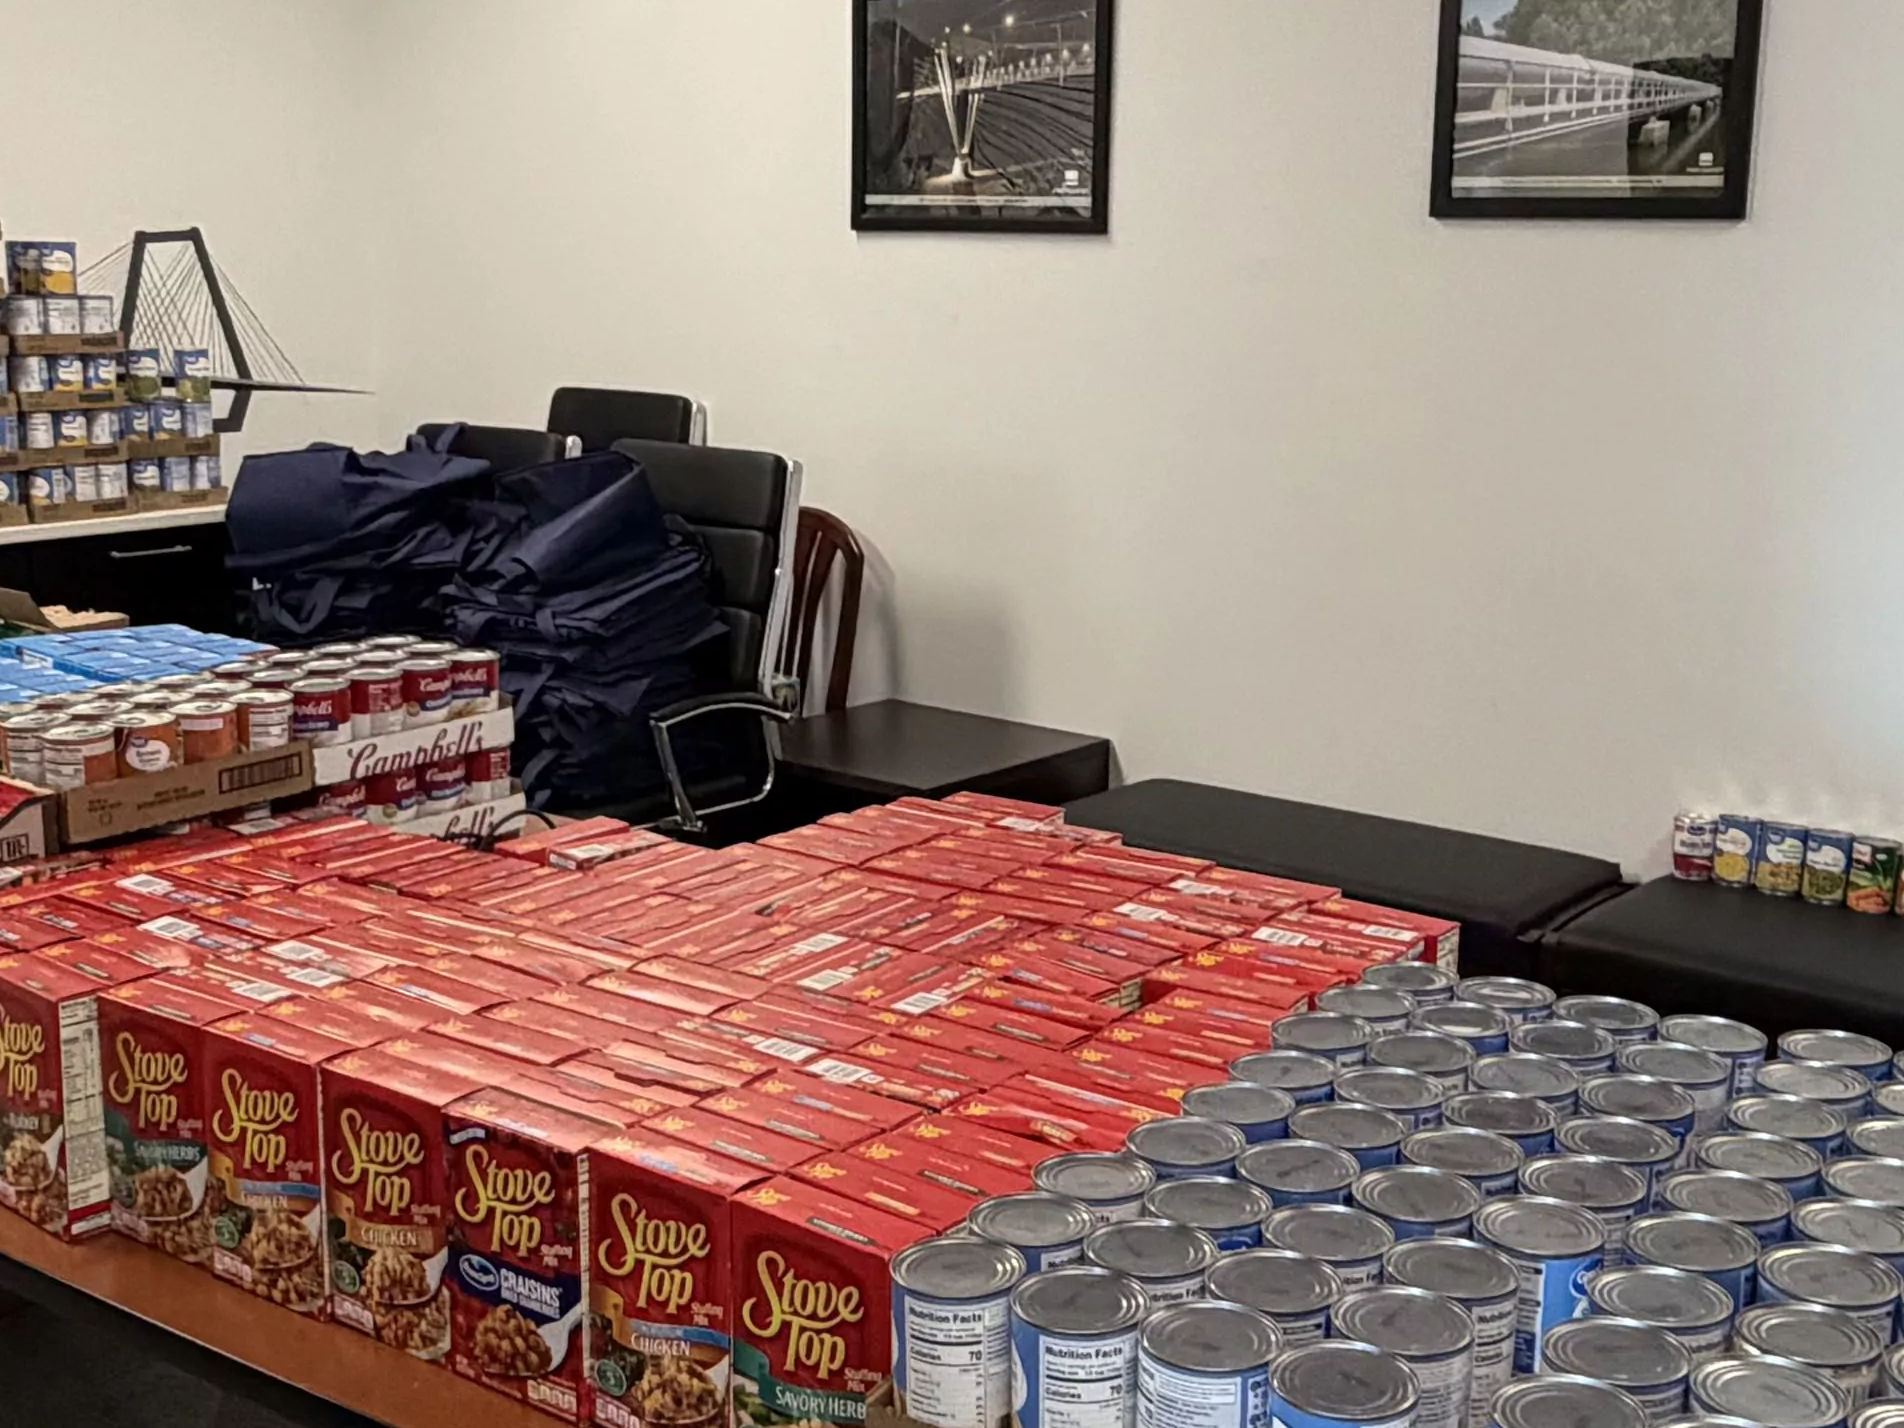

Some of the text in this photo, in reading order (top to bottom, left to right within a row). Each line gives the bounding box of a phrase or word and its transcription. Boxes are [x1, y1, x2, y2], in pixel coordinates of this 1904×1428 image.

[348, 721, 483, 780] Campbell's
[3, 1053, 38, 1101] Top
[109, 1032, 188, 1103] Stove
[130, 1083, 178, 1131] Top
[212, 1068, 299, 1143] Stove
[234, 1121, 287, 1172] Top
[331, 1108, 425, 1185] Stove
[241, 1192, 288, 1210] CHICKEN
[356, 1162, 412, 1216] Top
[455, 1145, 555, 1223] Stove
[361, 1227, 418, 1247] CHICKEN
[484, 1200, 542, 1258] Top
[598, 1193, 710, 1276] Stove
[629, 1253, 694, 1314] Top
[742, 1251, 865, 1338] Stove
[909, 1305, 983, 1325] Nutrition Facts
[631, 1333, 691, 1357] CHICKEN
[772, 1314, 845, 1380] Top
[968, 1350, 983, 1362] 70
[1046, 1345, 1124, 1361] Nutrition Facts
[775, 1386, 867, 1420] SAVORY HERB
[1109, 1384, 1123, 1396] 70
